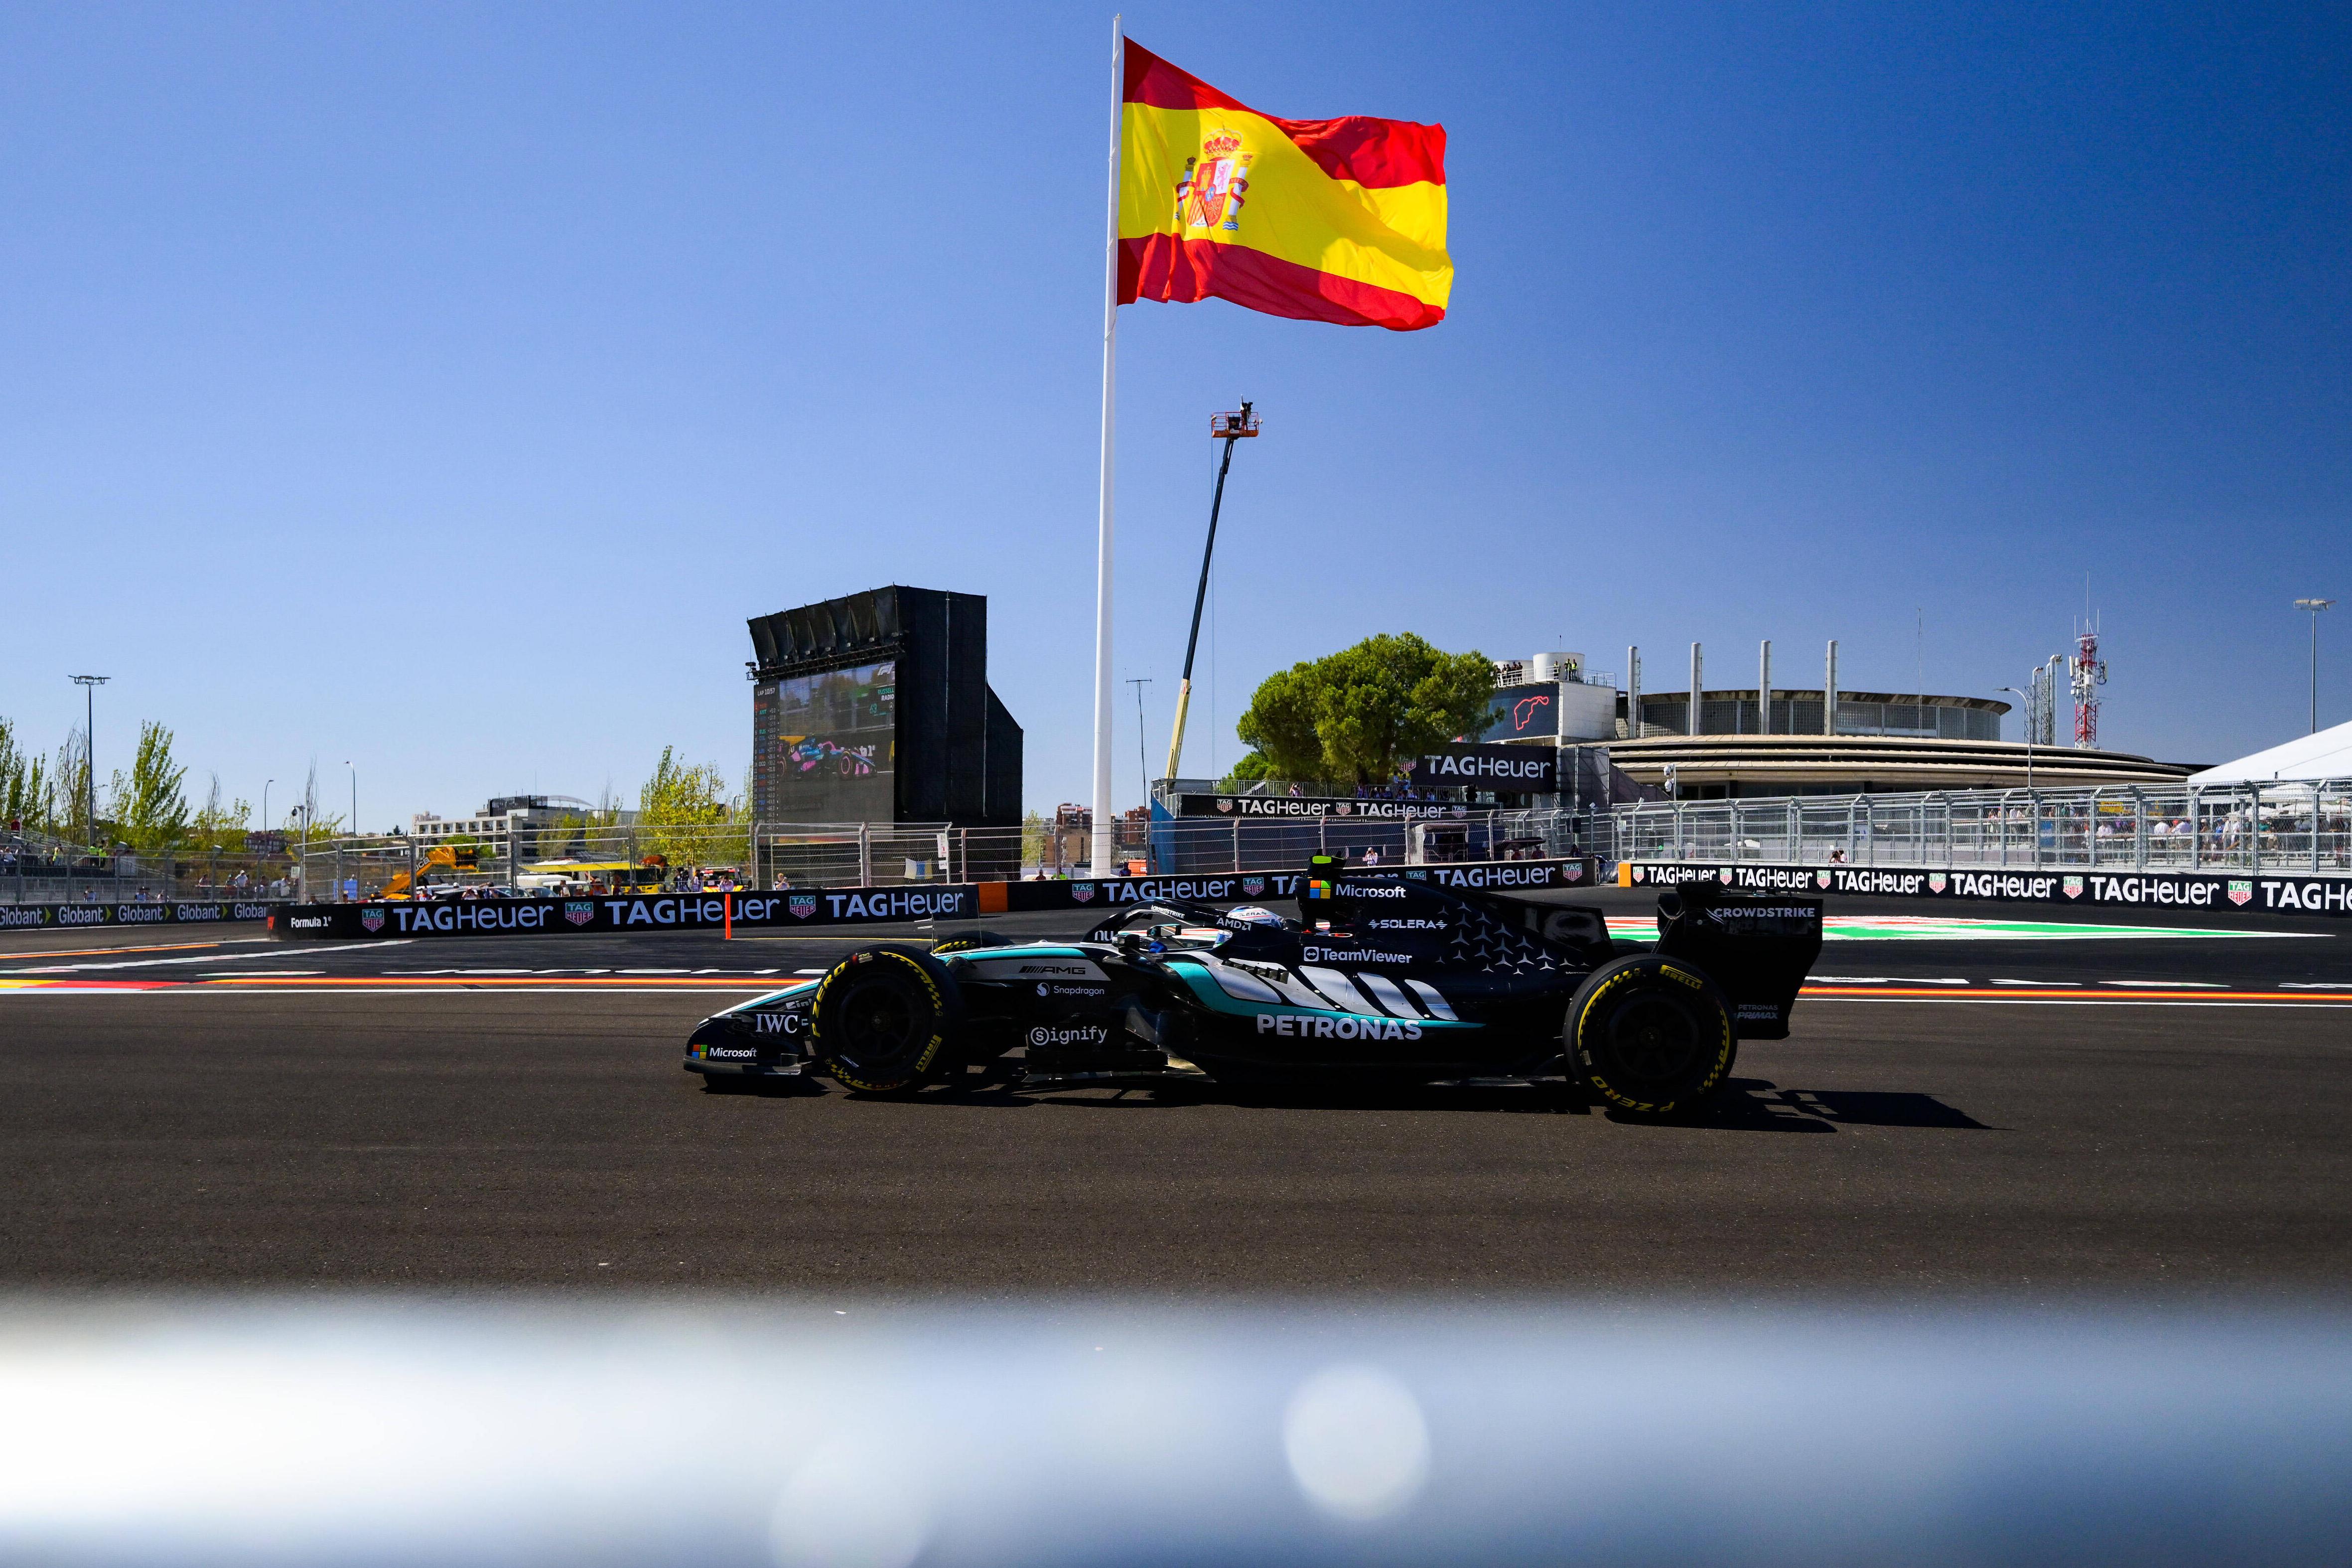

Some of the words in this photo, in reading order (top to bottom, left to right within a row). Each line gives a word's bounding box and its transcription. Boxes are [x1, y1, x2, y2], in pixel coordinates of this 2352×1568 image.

[1336, 884, 1406, 898] Microsoft
[2229, 881, 2251, 890] TAG
[57, 905, 104, 924] Globant
[118, 904, 164, 923] Globant
[177, 903, 221, 922] Globant
[234, 902, 267, 920] Globa
[1714, 907, 1815, 918] CROWDSTRIKE
[290, 916, 322, 928] Formula
[1216, 917, 1242, 929] AMD
[1380, 919, 1436, 929] SOLERA
[1320, 948, 1412, 963] TeamViewer
[1041, 967, 1086, 975] AMG
[1660, 965, 1702, 990] PIRELLI
[812, 961, 848, 1018] ZERO
[1054, 986, 1105, 997] Snapdragon
[755, 1014, 798, 1033] IWC
[812, 1022, 821, 1037] P
[1257, 1013, 1422, 1040] PETRONAS
[1030, 1025, 1107, 1046] signify
[709, 1047, 757, 1057] Microsoft
[915, 1034, 943, 1073] PIRELLI
[1590, 1076, 1655, 1112] ZERO
[1659, 1102, 1674, 1112] P
